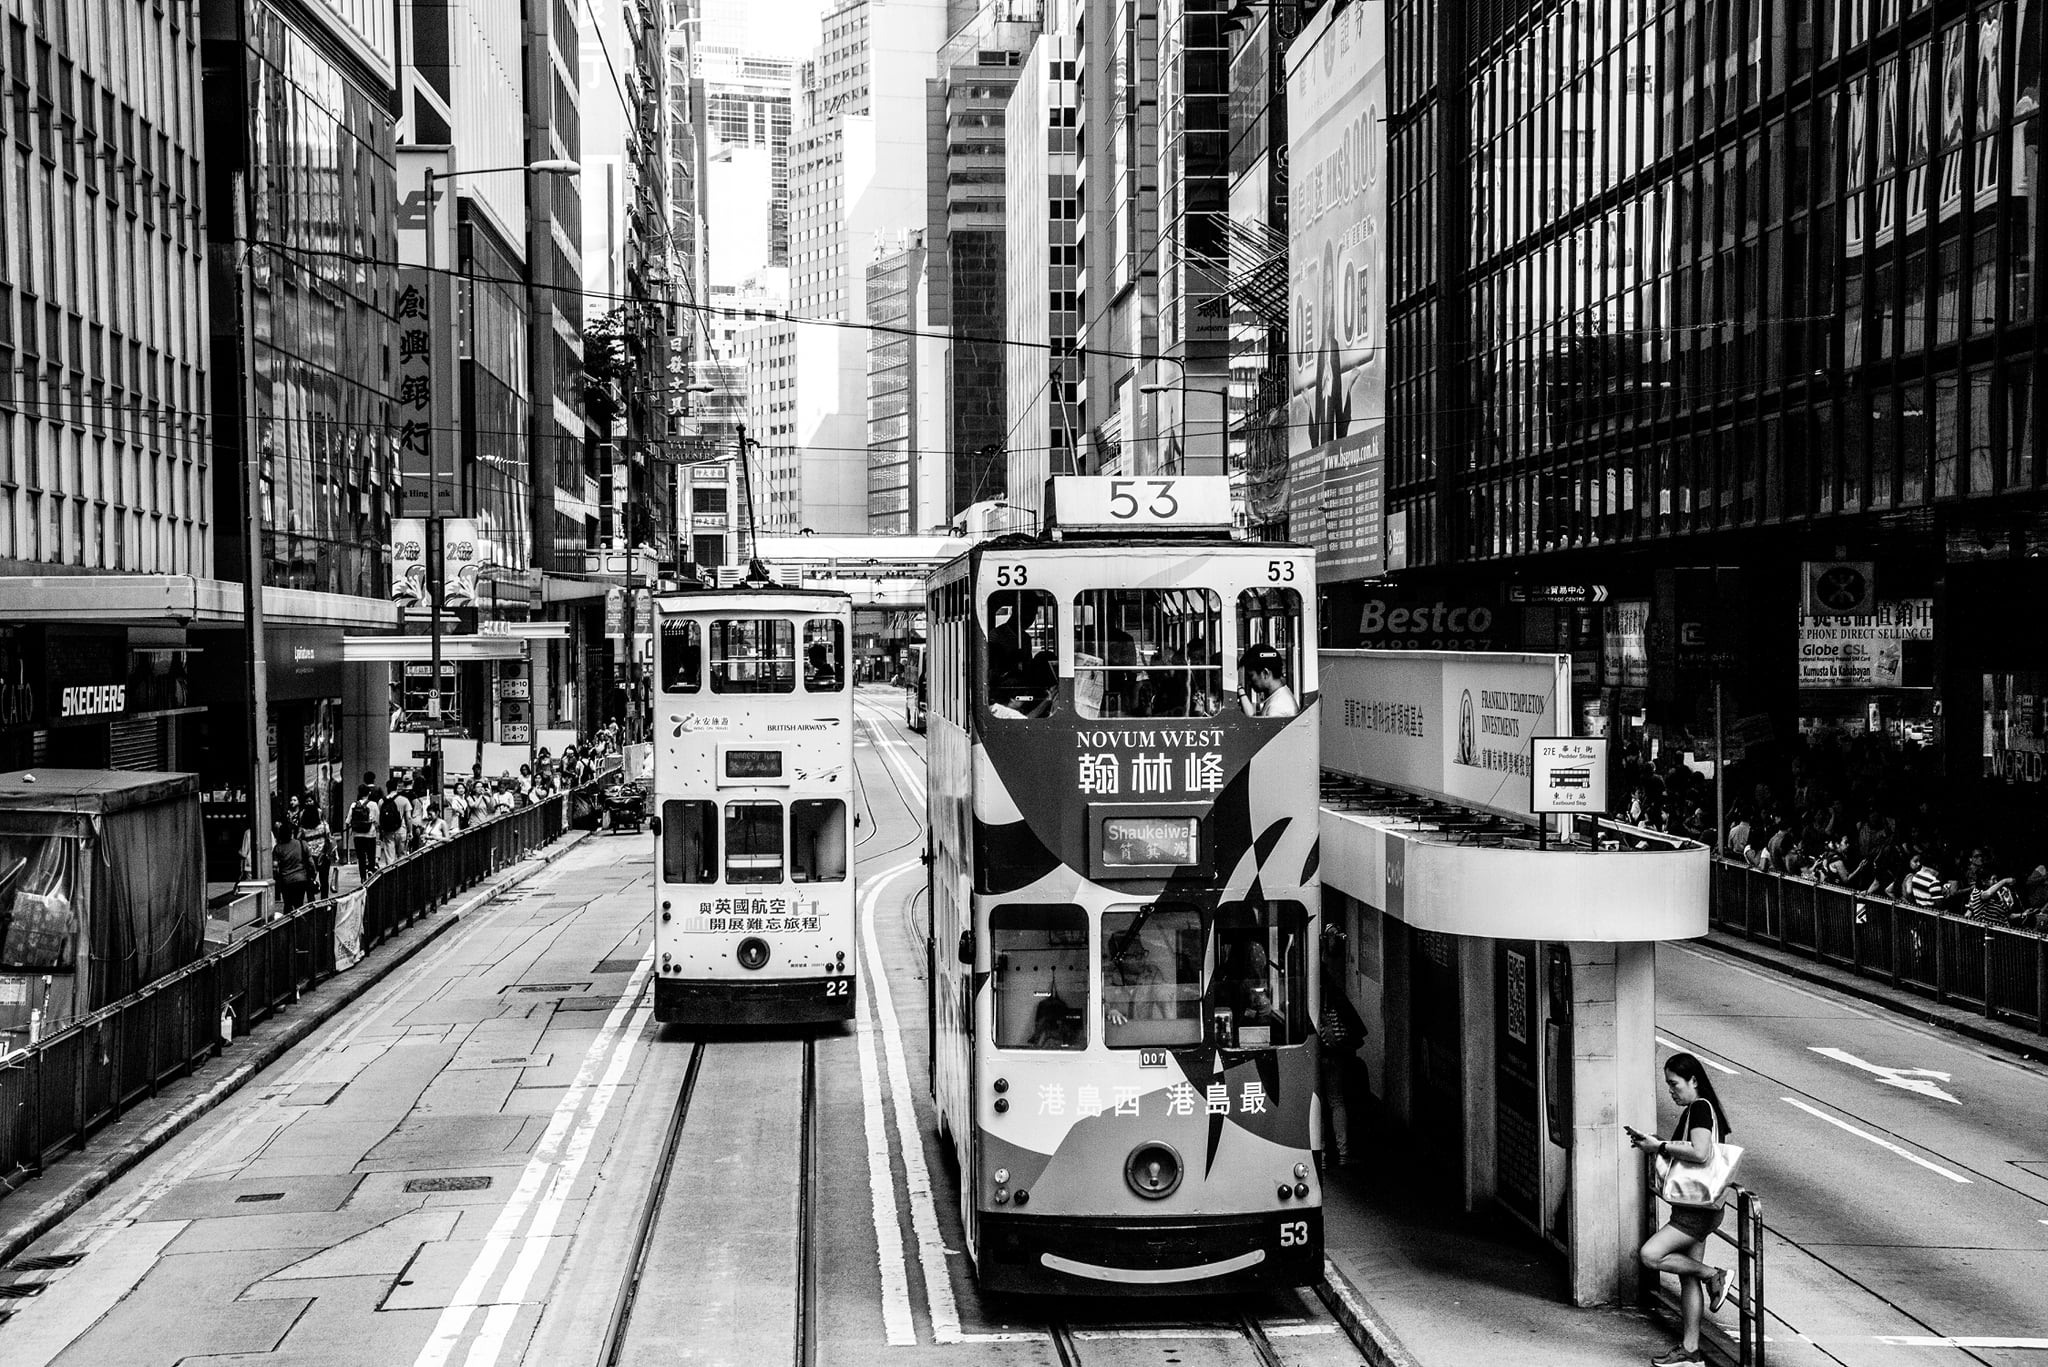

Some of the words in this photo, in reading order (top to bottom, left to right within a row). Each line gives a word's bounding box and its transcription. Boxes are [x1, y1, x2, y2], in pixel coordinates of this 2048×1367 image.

[666, 337, 687, 415] 日發文具
[665, 452, 716, 460] STATIONERS
[409, 489, 429, 499] Hing
[1110, 480, 1179, 519] 53
[997, 565, 1028, 587] 53
[1268, 560, 1295, 583] 53
[1360, 599, 1493, 634] Bestco
[1807, 629, 1837, 640] PHONE
[1841, 629, 1875, 640] DIRECT
[1878, 628, 1918, 640] SELLING
[1803, 644, 1839, 656] Globe
[1843, 644, 1868, 656] CSL
[1803, 665, 1829, 677] Kumusta
[1830, 665, 1837, 677] Ka
[62, 683, 126, 717] SKECHERS
[1481, 690, 1509, 711] FRANKLIN
[1509, 692, 1544, 715] TEMPLETON
[1481, 715, 1520, 738] INVESTMENTS
[1077, 731, 1155, 748] NOVUM
[1160, 730, 1225, 747] WEST
[1544, 747, 1556, 757] 27E
[1078, 752, 1225, 795] 翰林峰
[1992, 749, 2042, 783] WORLD
[700, 898, 786, 915] 與英國航空
[710, 917, 819, 931] 開展難忘旅程
[827, 981, 848, 997] 22
[1142, 1053, 1167, 1066] 007
[1038, 1083, 1142, 1118] 港島西
[1165, 1081, 1267, 1118] 港島最
[1280, 1223, 1309, 1247] 53
